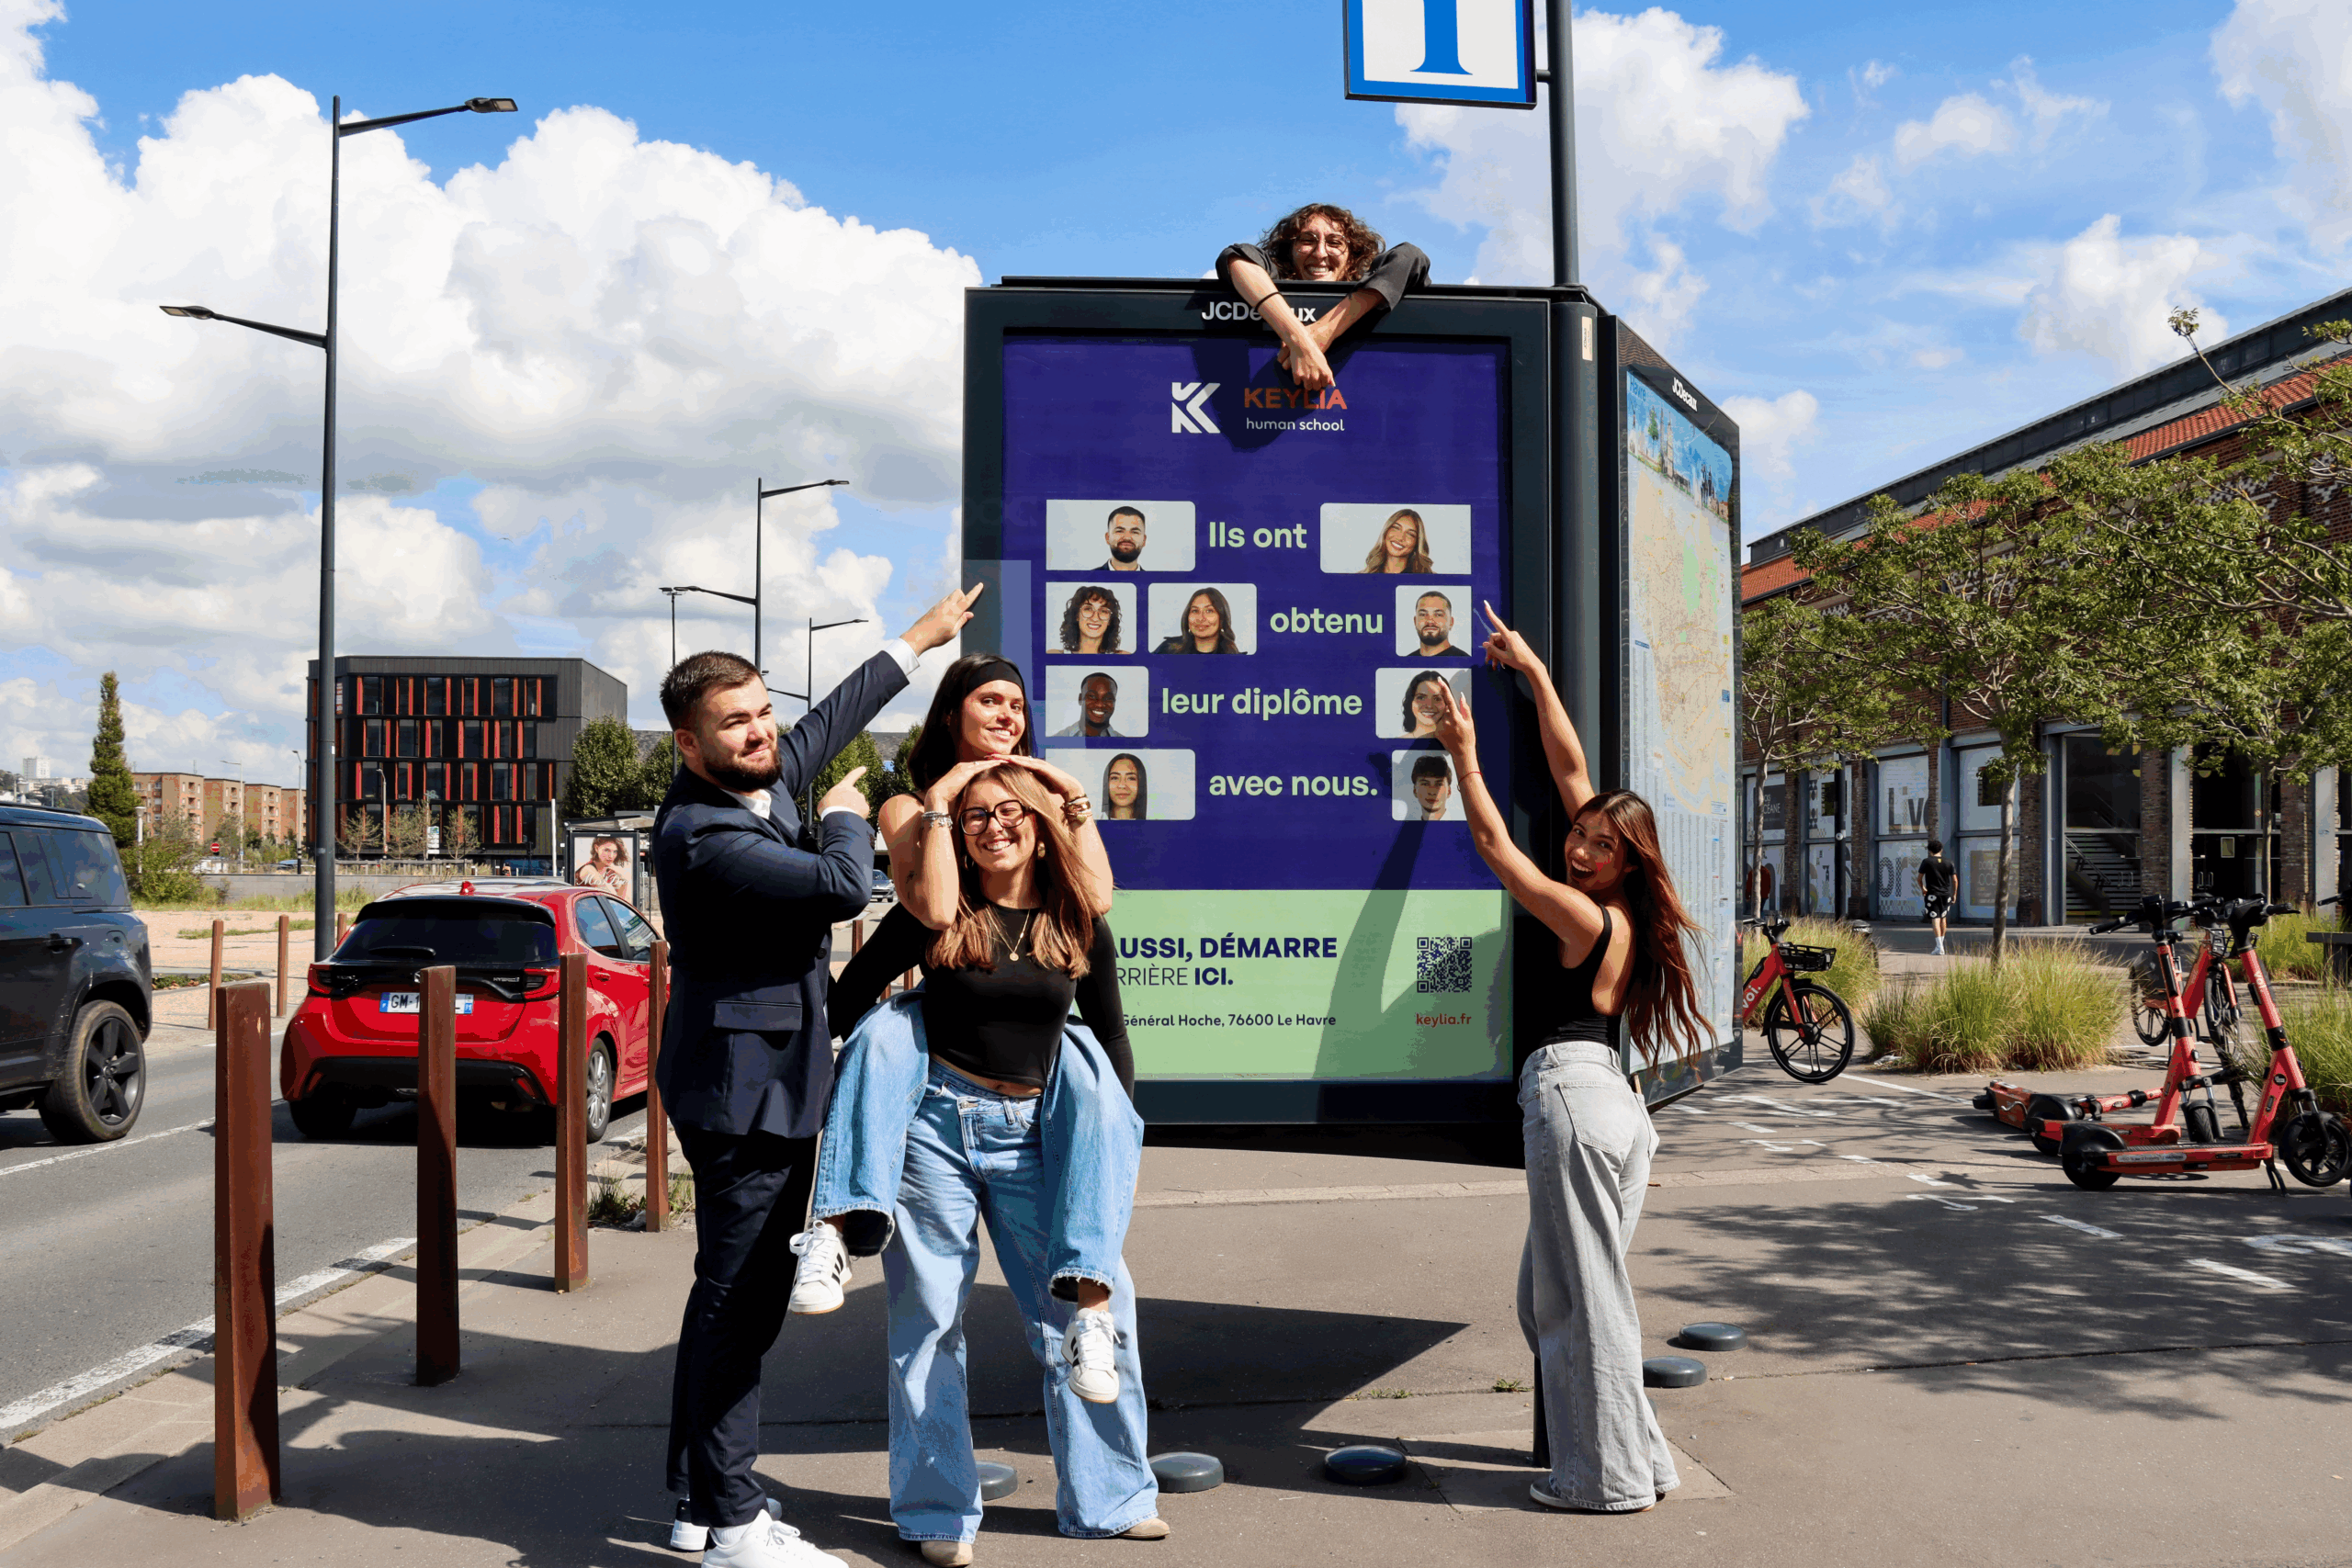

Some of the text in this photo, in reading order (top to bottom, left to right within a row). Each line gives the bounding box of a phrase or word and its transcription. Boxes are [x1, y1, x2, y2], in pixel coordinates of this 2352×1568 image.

[1202, 301, 1317, 321] JCDeux
[1244, 388, 1348, 410] KEYLIA
[1672, 377, 1698, 412] JCDecaux
[1246, 417, 1345, 431] human school
[1209, 522, 1307, 549] Ils ont
[1270, 606, 1383, 634] obtenu
[1162, 687, 1363, 721] leur diplôme
[1209, 775, 1378, 796] avec nous.
[1763, 800, 1781, 815] CÉANE
[1889, 786, 1929, 834] Liv
[1114, 931, 1338, 963] USSI, DÉMARRE
[1116, 963, 1234, 986] RRIÈRE ICI.
[1123, 1013, 1337, 1027] Général Hoche, 76600 Le Havre
[1416, 1013, 1472, 1028] keylia.fr
